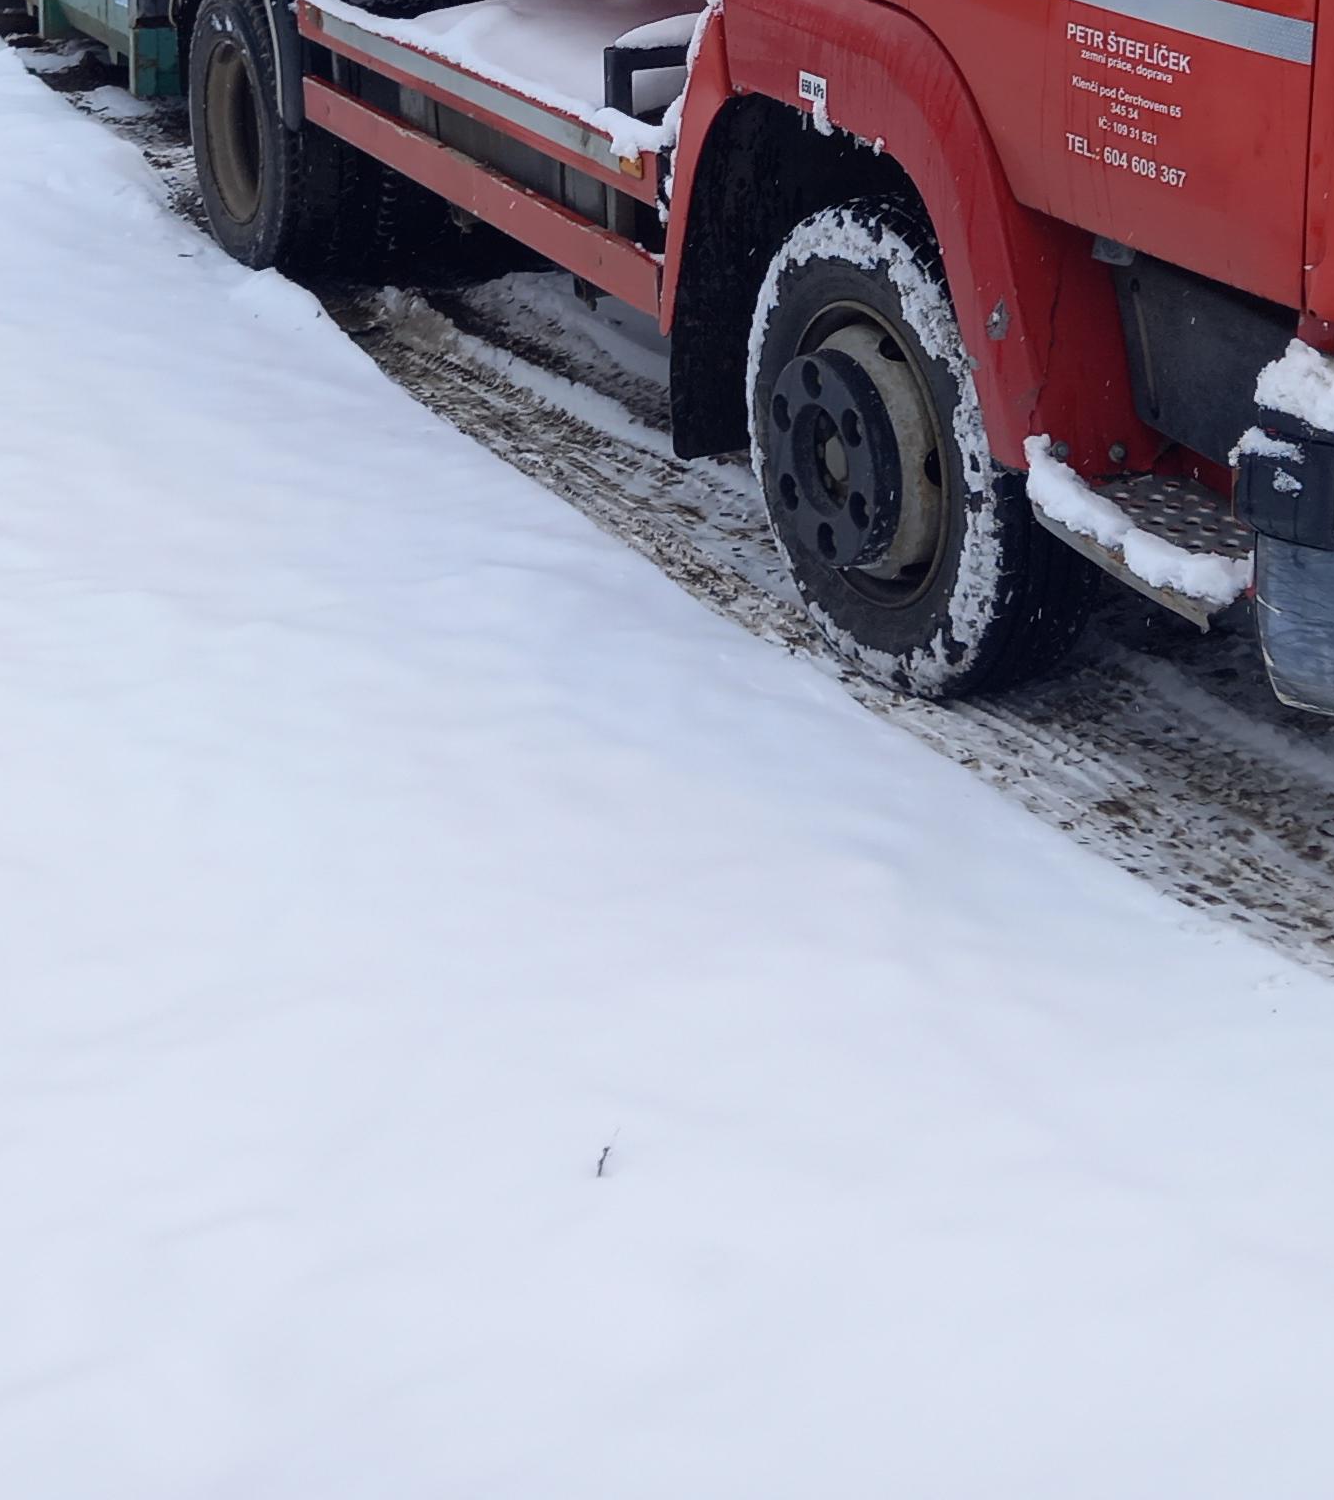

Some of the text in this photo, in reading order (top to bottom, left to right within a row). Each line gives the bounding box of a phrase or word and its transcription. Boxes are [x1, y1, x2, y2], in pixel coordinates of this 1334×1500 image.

[1067, 22, 1192, 74] PETR ŠTEFLÍČEK
[1080, 49, 1173, 84] zemní práce, doprava
[1072, 75, 1099, 93] Klenčí
[1099, 86, 1117, 99] pod
[1117, 87, 1168, 115] Čerchovem
[1110, 102, 1139, 120] 345 34
[1098, 115, 1157, 146] IČ: 109 31 821
[1066, 132, 1187, 188] TEL.: 604 608 367
